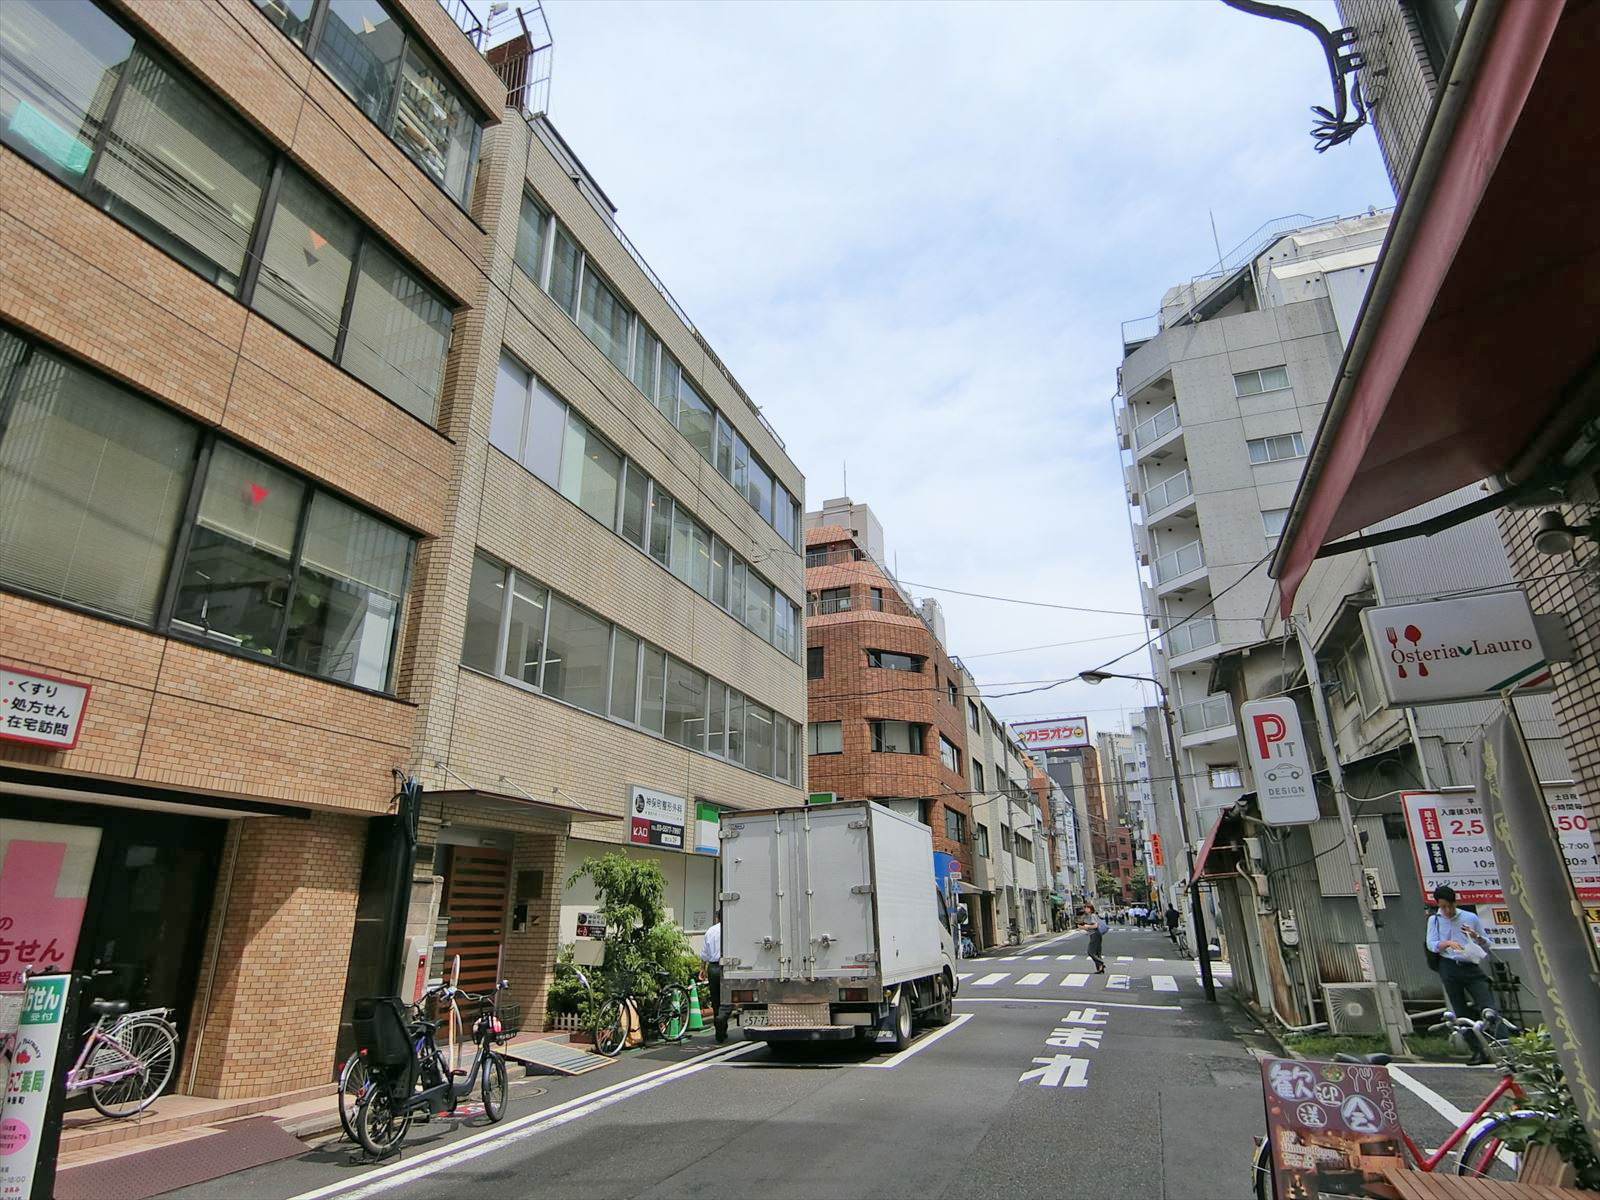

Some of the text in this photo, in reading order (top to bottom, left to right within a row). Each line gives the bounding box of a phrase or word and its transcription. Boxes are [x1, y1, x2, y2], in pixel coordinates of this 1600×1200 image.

[1391, 638, 1533, 664] Osteria Lauro
[18, 681, 58, 698] くすり
[11, 697, 70, 719] 処方せん
[7, 714, 69, 737] 在宅訪問
[1025, 726, 1073, 741] カラオケ
[1253, 713, 1296, 759] PIT
[1268, 786, 1305, 797] DESIGN
[1554, 793, 1579, 801] 土日祝
[1018, 1007, 1110, 1088] 止まれ
